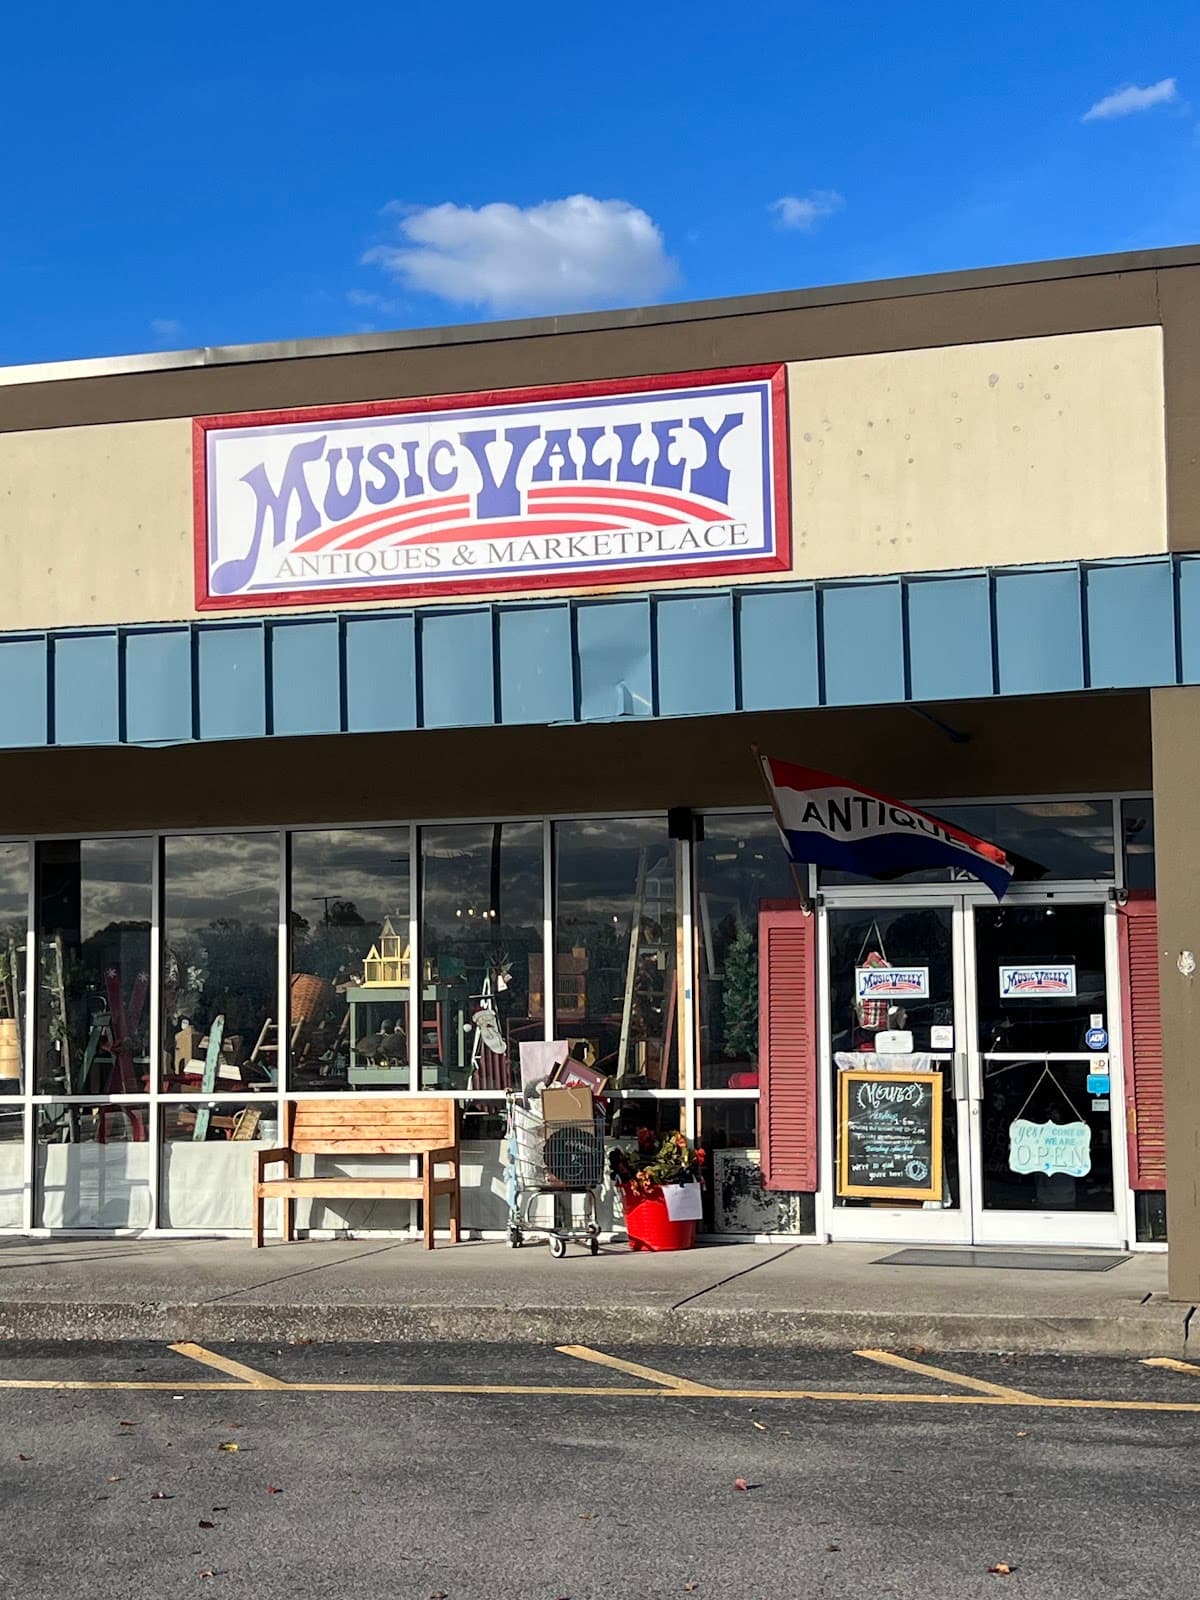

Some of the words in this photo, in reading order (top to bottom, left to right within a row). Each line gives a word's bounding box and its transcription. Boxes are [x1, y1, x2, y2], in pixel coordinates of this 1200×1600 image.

[210, 435, 460, 594] MUSIC
[458, 412, 744, 519] VALLEY
[275, 546, 441, 579] ANTIQUES
[452, 543, 476, 565] &
[488, 522, 748, 564] MARKETPLACE
[1017, 1145, 1086, 1168] OPEN
